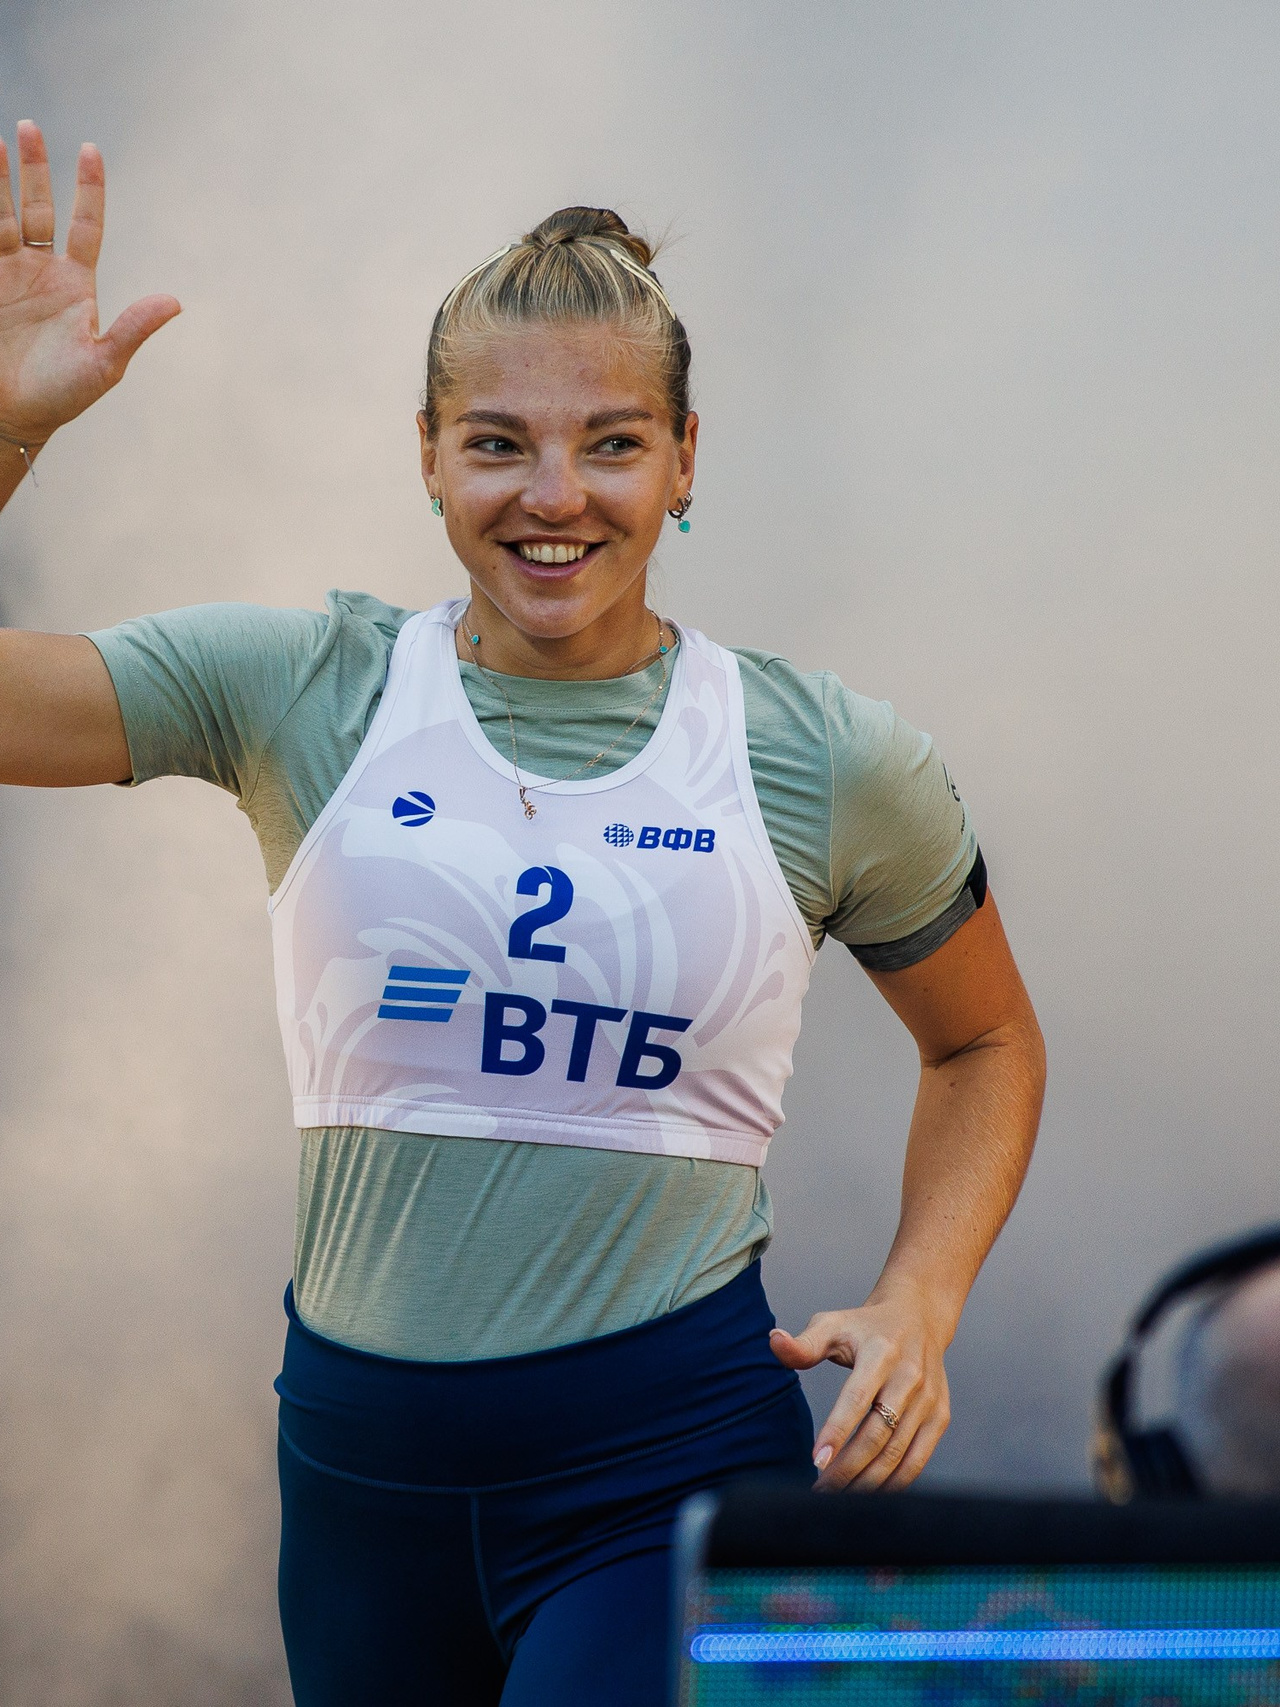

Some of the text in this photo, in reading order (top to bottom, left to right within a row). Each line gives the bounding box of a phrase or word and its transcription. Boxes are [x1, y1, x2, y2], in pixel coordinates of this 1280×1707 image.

[636, 825, 716, 853] ВФВ
[508, 865, 574, 963] 2
[481, 991, 693, 1090] ВТБ
